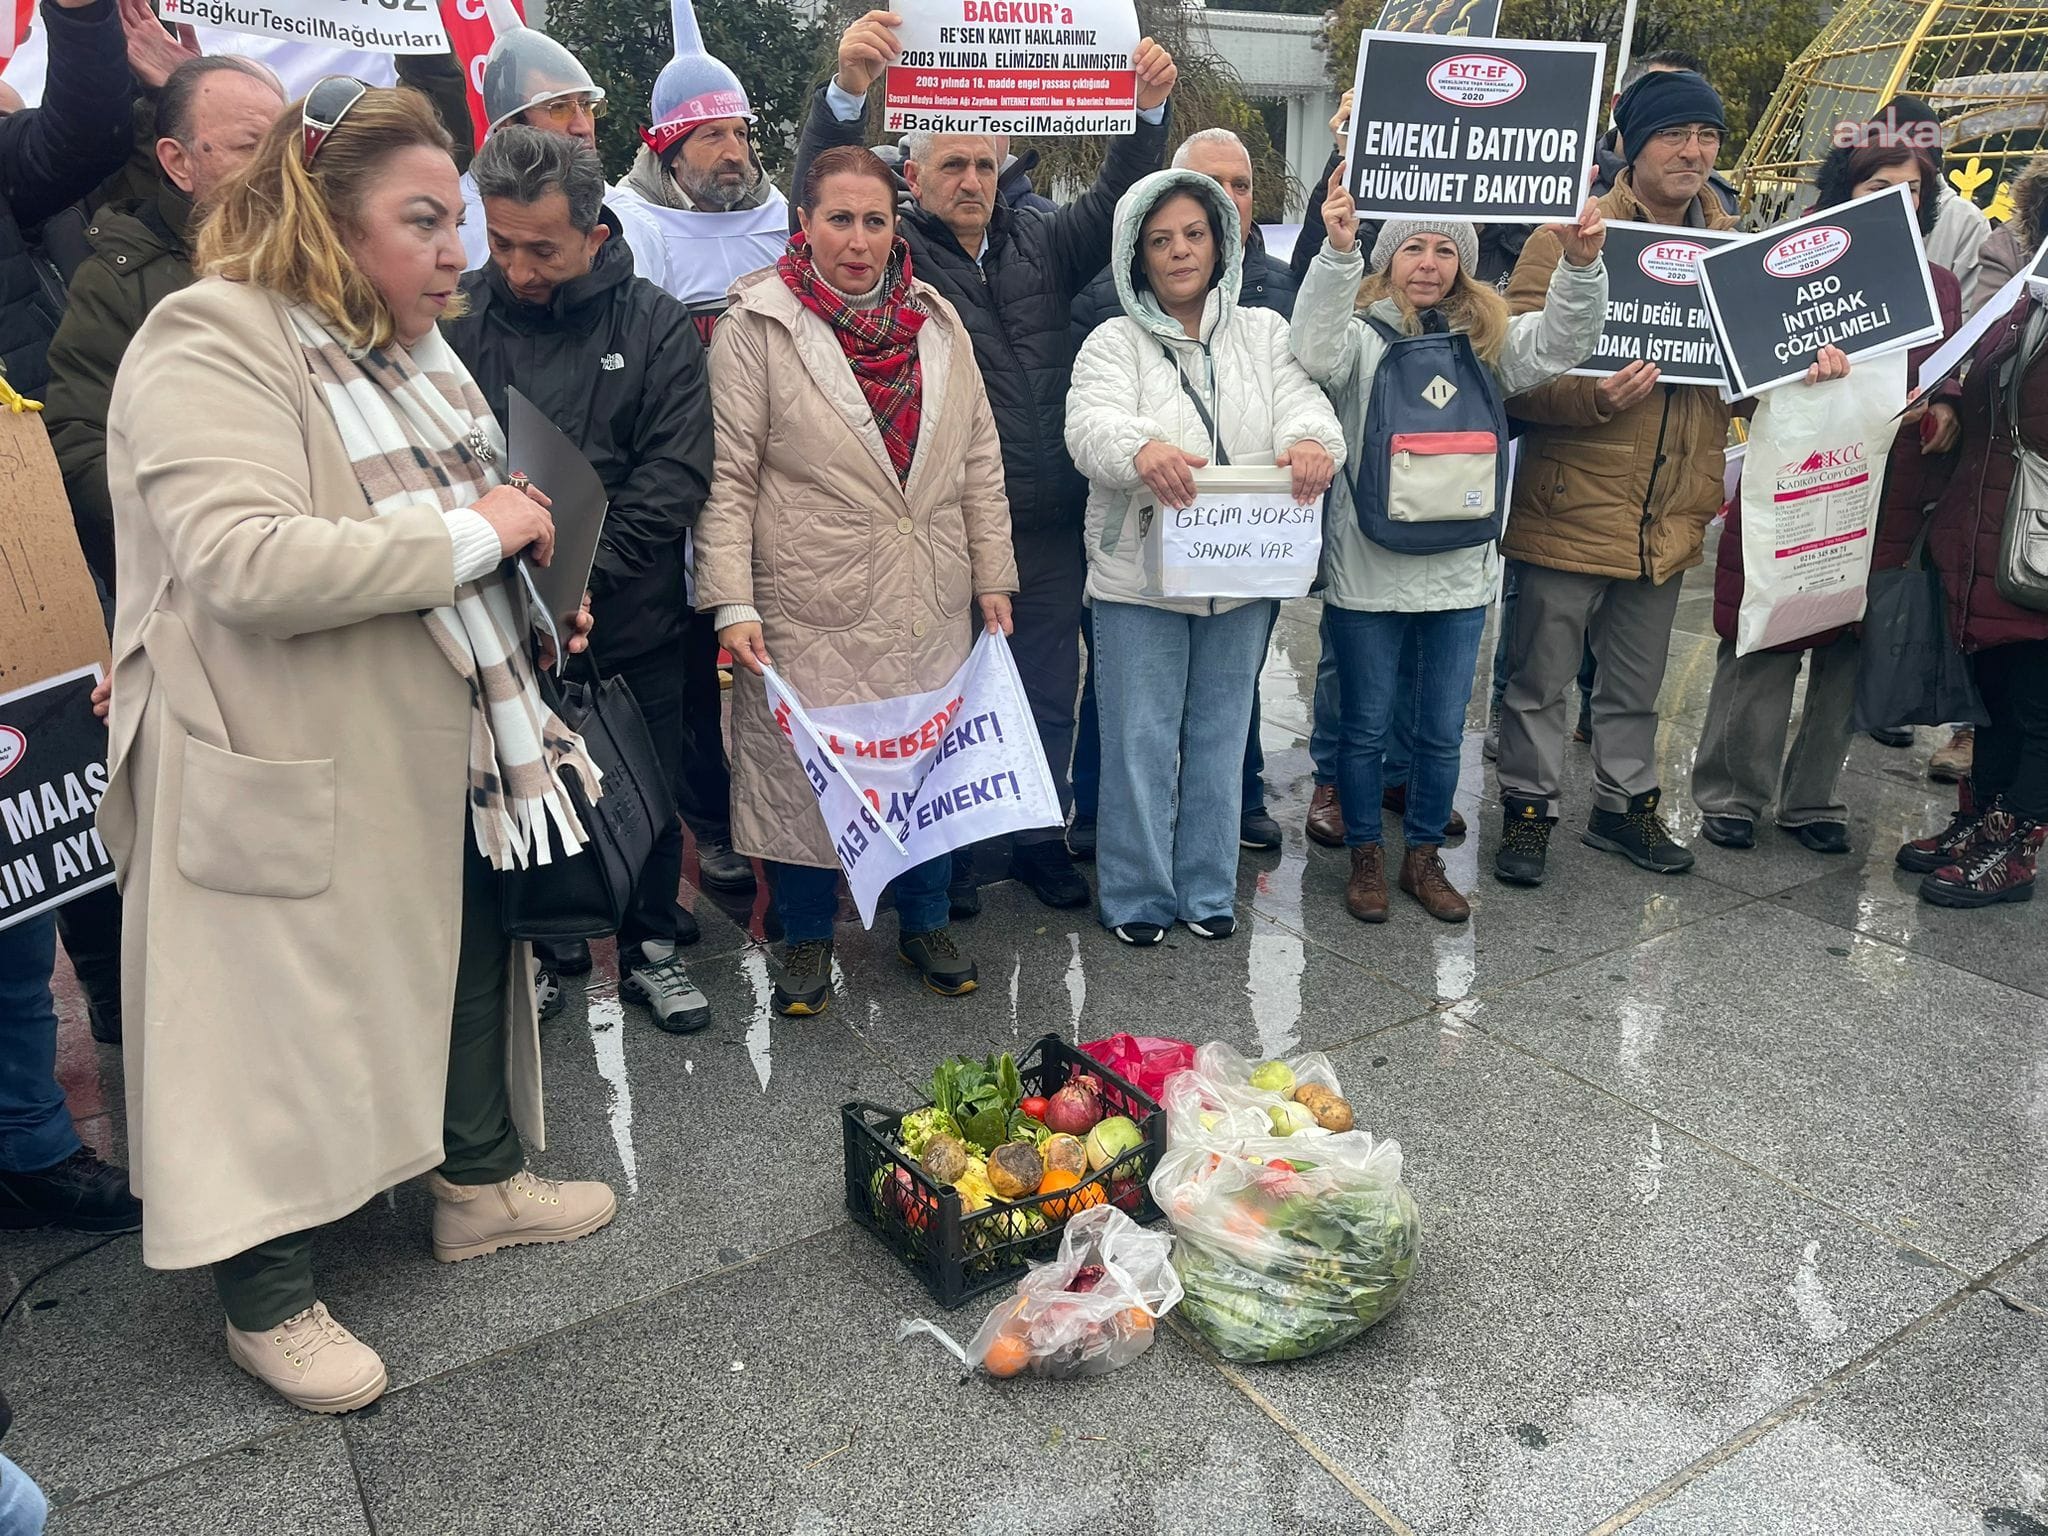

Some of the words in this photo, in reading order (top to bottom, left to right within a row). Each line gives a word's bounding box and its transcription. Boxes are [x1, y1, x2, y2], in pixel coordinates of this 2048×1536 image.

[940, 28, 985, 44] RE'SEN
[988, 29, 1021, 45] KAYIT
[1025, 30, 1096, 46] HAKLARIMIZ
[901, 51, 934, 67] 2003
[939, 52, 988, 68] YILINDA
[995, 49, 1057, 69] ELİMİZDEN
[1062, 53, 1128, 70] ALINMIŞTIR
[1448, 63, 1508, 79] EYT-EF
[916, 76, 939, 88] 2003
[940, 76, 970, 90] yılında
[972, 76, 986, 88] 18.
[987, 77, 1016, 89] madde
[1017, 77, 1040, 90] engel
[1041, 79, 1071, 90] yassası
[1072, 78, 1110, 91] çıktığında
[888, 93, 911, 104] Sosyal
[911, 94, 933, 105] Medya
[1461, 93, 1484, 101] 2020
[889, 112, 1131, 134] #BağkurTescilMağdurları
[1365, 117, 1460, 159] EMEKLİ
[1466, 126, 1578, 163] BATIYOR
[1359, 163, 1468, 203] HÜKÜMET
[1473, 174, 1573, 205] BAKIYOR
[1779, 231, 1831, 258] EYT-EF
[1667, 271, 1686, 280] 2020
[1799, 259, 1820, 271] 2020
[1796, 275, 1841, 306] ABO
[1604, 299, 1639, 324] ENCİ
[1642, 301, 1683, 328] DEĞİL
[1687, 308, 1710, 329] EM
[1782, 290, 1868, 334] İNTİBAK
[1592, 333, 1641, 359] DAKA
[1774, 303, 1891, 364] ÇÖZÜLMELİ
[1828, 441, 1864, 468] KCC
[1776, 474, 1818, 491] KADIKÖY
[1819, 470, 1844, 482] COPY
[1844, 463, 1868, 478] CENTER
[1175, 504, 1242, 529] GEÇİM
[1247, 506, 1315, 526] YOKSA
[1187, 541, 1252, 560] SANDIK
[1260, 541, 1294, 559] VAR
